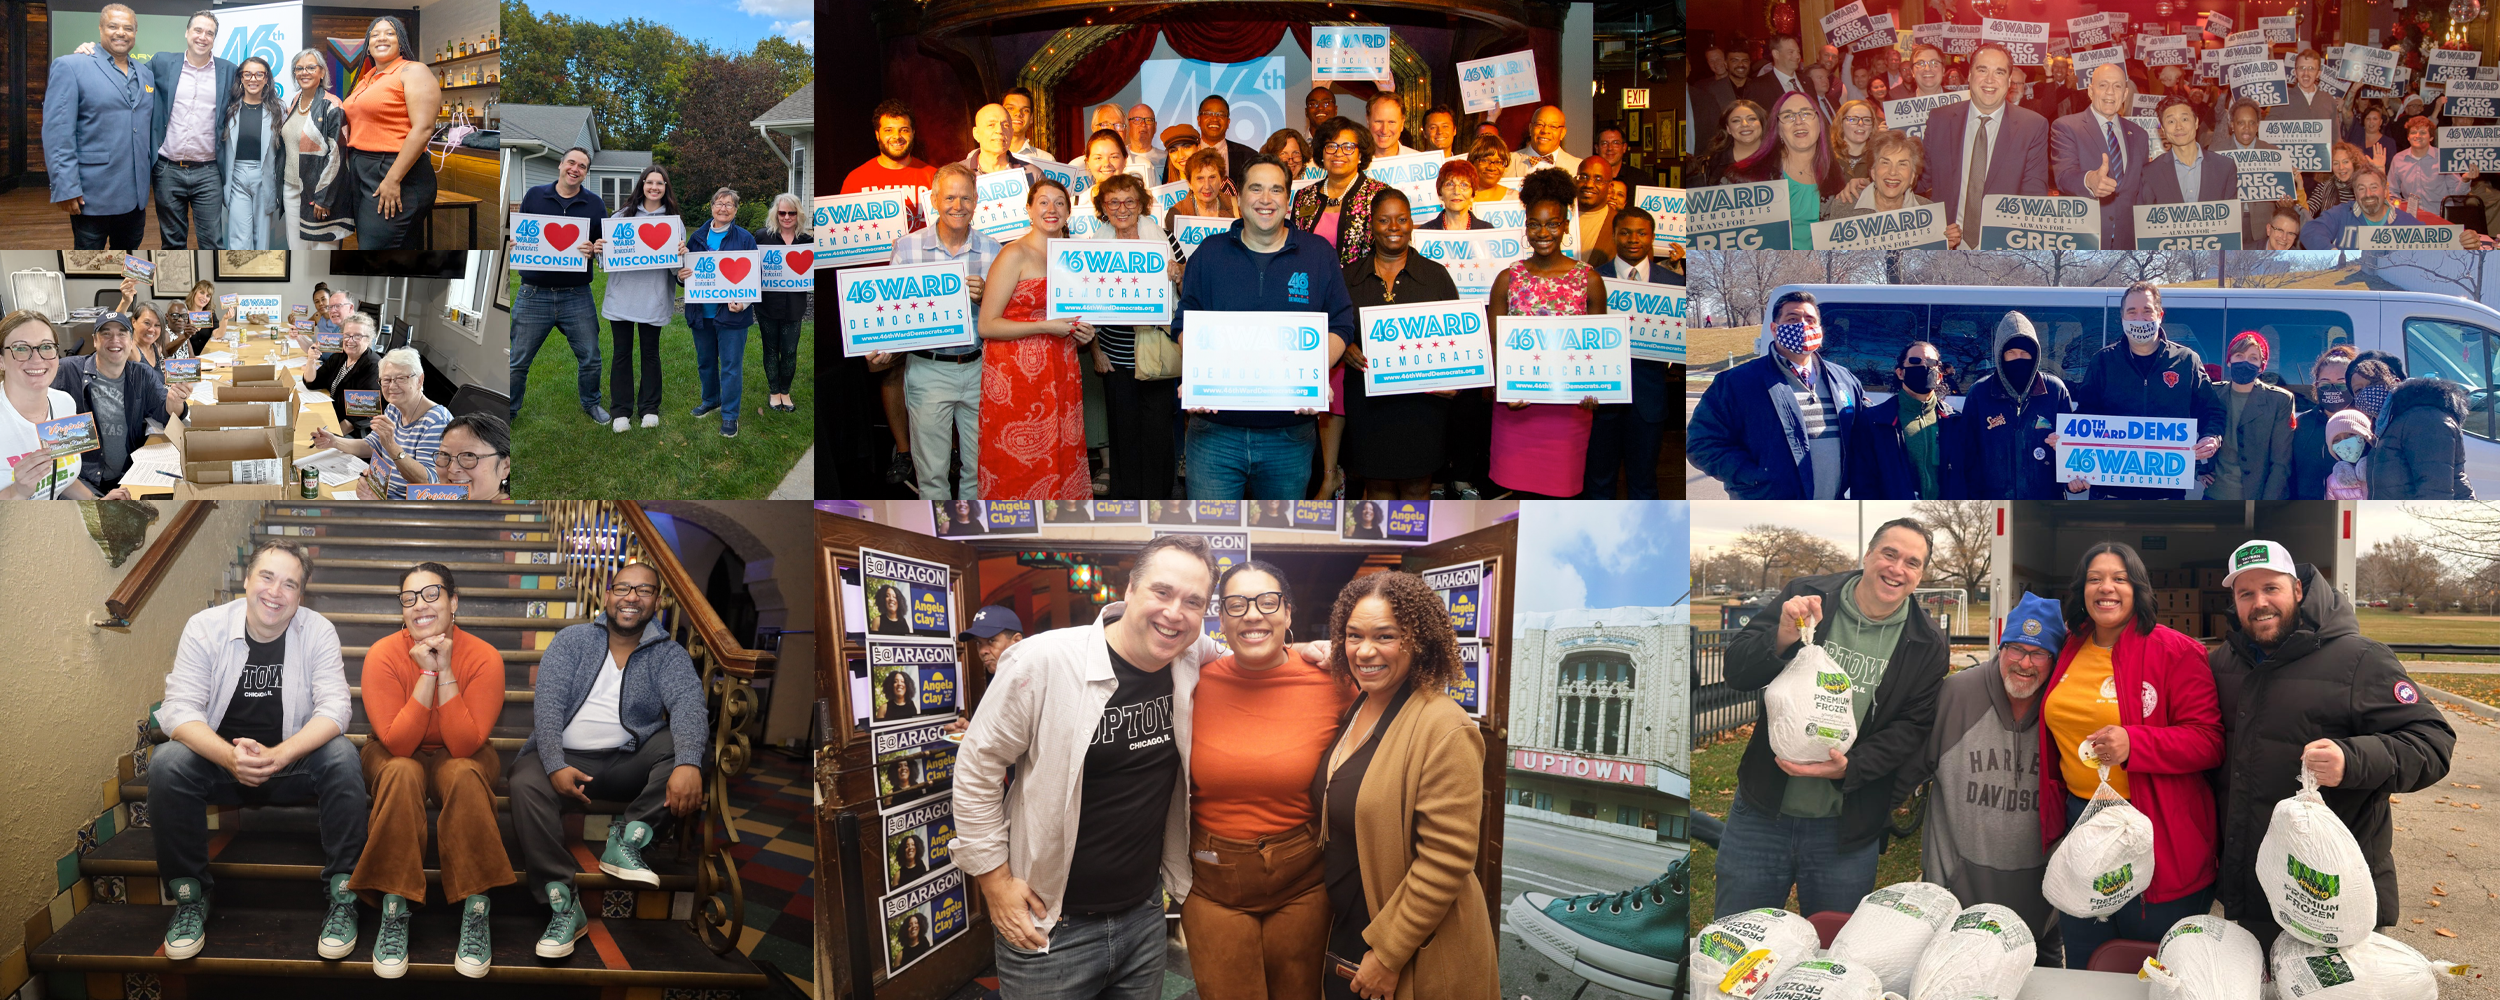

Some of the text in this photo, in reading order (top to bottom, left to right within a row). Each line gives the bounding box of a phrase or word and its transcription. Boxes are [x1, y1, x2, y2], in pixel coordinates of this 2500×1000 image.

[1832, 3, 1859, 21] WARD
[1833, 19, 1861, 37] GREG
[2003, 22, 2042, 34] WARD
[2078, 27, 2103, 39] GREG
[2211, 22, 2227, 32] GREG
[1334, 34, 1386, 48] WARD
[1832, 25, 1869, 47] HARRIS
[1857, 36, 1893, 50] HARRIS
[2077, 33, 2107, 46] HARRIS
[2265, 34, 2291, 42] HARRIS
[2090, 48, 2118, 60] WARD
[2154, 50, 2179, 58] GREG
[2233, 46, 2263, 56] WARD
[2446, 51, 2476, 60] WARD
[2151, 56, 2183, 65] HARRIS
[2241, 61, 2278, 75] WARD
[2438, 66, 2468, 75] GREG
[2240, 82, 2275, 97] GREG
[2464, 81, 2499, 91] WARD
[1627, 90, 1646, 104] EXIT
[2456, 97, 2492, 108] GREG
[2451, 106, 2496, 116] HARRIS
[2280, 121, 2323, 134] WARD
[2234, 150, 2282, 162] WARD
[2453, 148, 2497, 161] GREG
[1686, 185, 1774, 214] WARD
[2238, 185, 2287, 200] ARRIS
[829, 200, 900, 224] WARD
[1690, 206, 1771, 223] DEMOCRATS
[2020, 198, 2088, 218] WARD
[2168, 203, 2230, 223] WARD
[1726, 218, 1745, 227] FOR
[1858, 209, 1937, 239] WARD
[2024, 215, 2085, 224] DEMOCRATS
[2173, 220, 2228, 229] DEMOCRATS
[1867, 229, 1935, 247] DEMOCRATS
[2006, 230, 2076, 249] GREG
[2391, 228, 2452, 243] WARD
[1897, 242, 1914, 250] FOR
[2158, 236, 2222, 250] GREG
[510, 253, 583, 266] WISCONSIN
[608, 254, 678, 267] WISCONSIN
[1084, 251, 1165, 273] WARD
[689, 288, 757, 298] WISCONSIN
[875, 273, 961, 301] WARD
[1055, 288, 1164, 298] DEMOCRATS
[1064, 304, 1155, 312] www.46thWardDemocrats.org
[850, 309, 963, 329] DEMOCRATS
[1398, 312, 1481, 340] WARD
[861, 328, 955, 342] www.46thWardDemocrats.org
[1534, 327, 1622, 351] WARD
[1372, 349, 1484, 369] DEMOCRATS
[1383, 368, 1476, 381] www.46thWardDemocrats.org
[1506, 364, 1622, 376] DEMOCRATS
[349, 393, 374, 401] Virginia
[45, 421, 84, 436] Virginia
[2092, 421, 2188, 442] WARD DEMS
[2096, 449, 2186, 476] WARD
[2101, 474, 2180, 485] DEMOCRATS
[990, 500, 1030, 513] Angela
[1096, 502, 1122, 515] Clay
[1199, 505, 1223, 516] Clay
[1298, 500, 1333, 511] Angela
[990, 513, 1017, 525] Clay
[1296, 510, 1319, 522] Clay
[1391, 510, 1425, 522] Angela
[1390, 521, 1412, 533] Clay
[887, 561, 945, 586] ARAGON
[1435, 569, 1478, 588] ARAGON
[914, 599, 945, 615] Angela
[1451, 602, 1475, 615] Angela
[914, 613, 935, 627] Clay
[895, 648, 953, 662] ARAGON
[922, 679, 953, 693] Angela
[922, 693, 943, 705] Clay
[1450, 689, 1466, 702] Clay
[1814, 694, 1850, 706] PREMIUM
[1815, 702, 1848, 714] FROZEN
[898, 726, 947, 747] ARAGO
[1129, 734, 1171, 750] CHICAGO, IL
[926, 755, 955, 770] Angela
[1523, 752, 1635, 782] UPTOWN
[1969, 748, 2040, 776] HARLE
[930, 845, 948, 859] Clay
[909, 869, 961, 907] ARAGON
[2090, 886, 2134, 905] PREMIUM
[2091, 893, 2131, 911] FROZEN
[2284, 883, 2339, 911] PREMIUM
[934, 901, 962, 922] Angela
[2286, 893, 2335, 920] FROZEN
[934, 917, 953, 934] Clay
